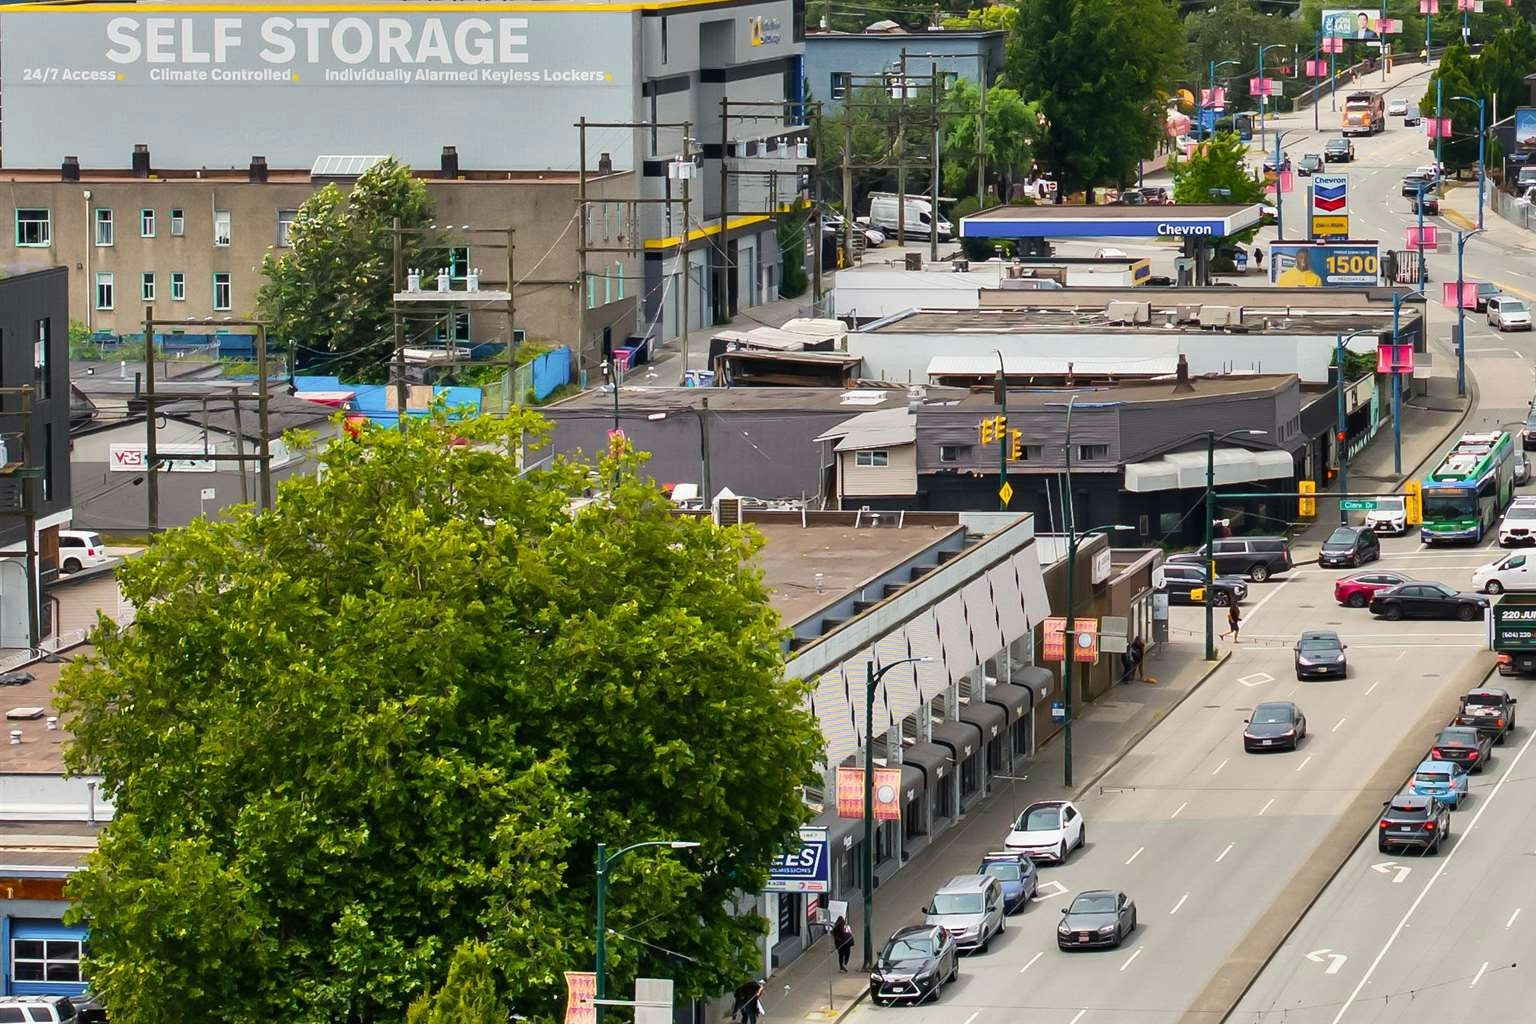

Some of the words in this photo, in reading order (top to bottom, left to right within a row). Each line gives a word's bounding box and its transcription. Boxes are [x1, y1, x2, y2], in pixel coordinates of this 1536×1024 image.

[105, 16, 243, 64] SELF
[259, 16, 529, 65] STORAGE
[23, 68, 59, 82] 24/7
[150, 68, 208, 81] Climate
[325, 68, 411, 84] Individually
[415, 68, 478, 81] Alarmed
[482, 68, 540, 84] Keyless
[1314, 176, 1346, 184] Chevron
[1157, 223, 1212, 235] Chevron
[1326, 255, 1377, 274] 1500
[115, 451, 142, 466] VRS
[1502, 611, 1520, 619] 220
